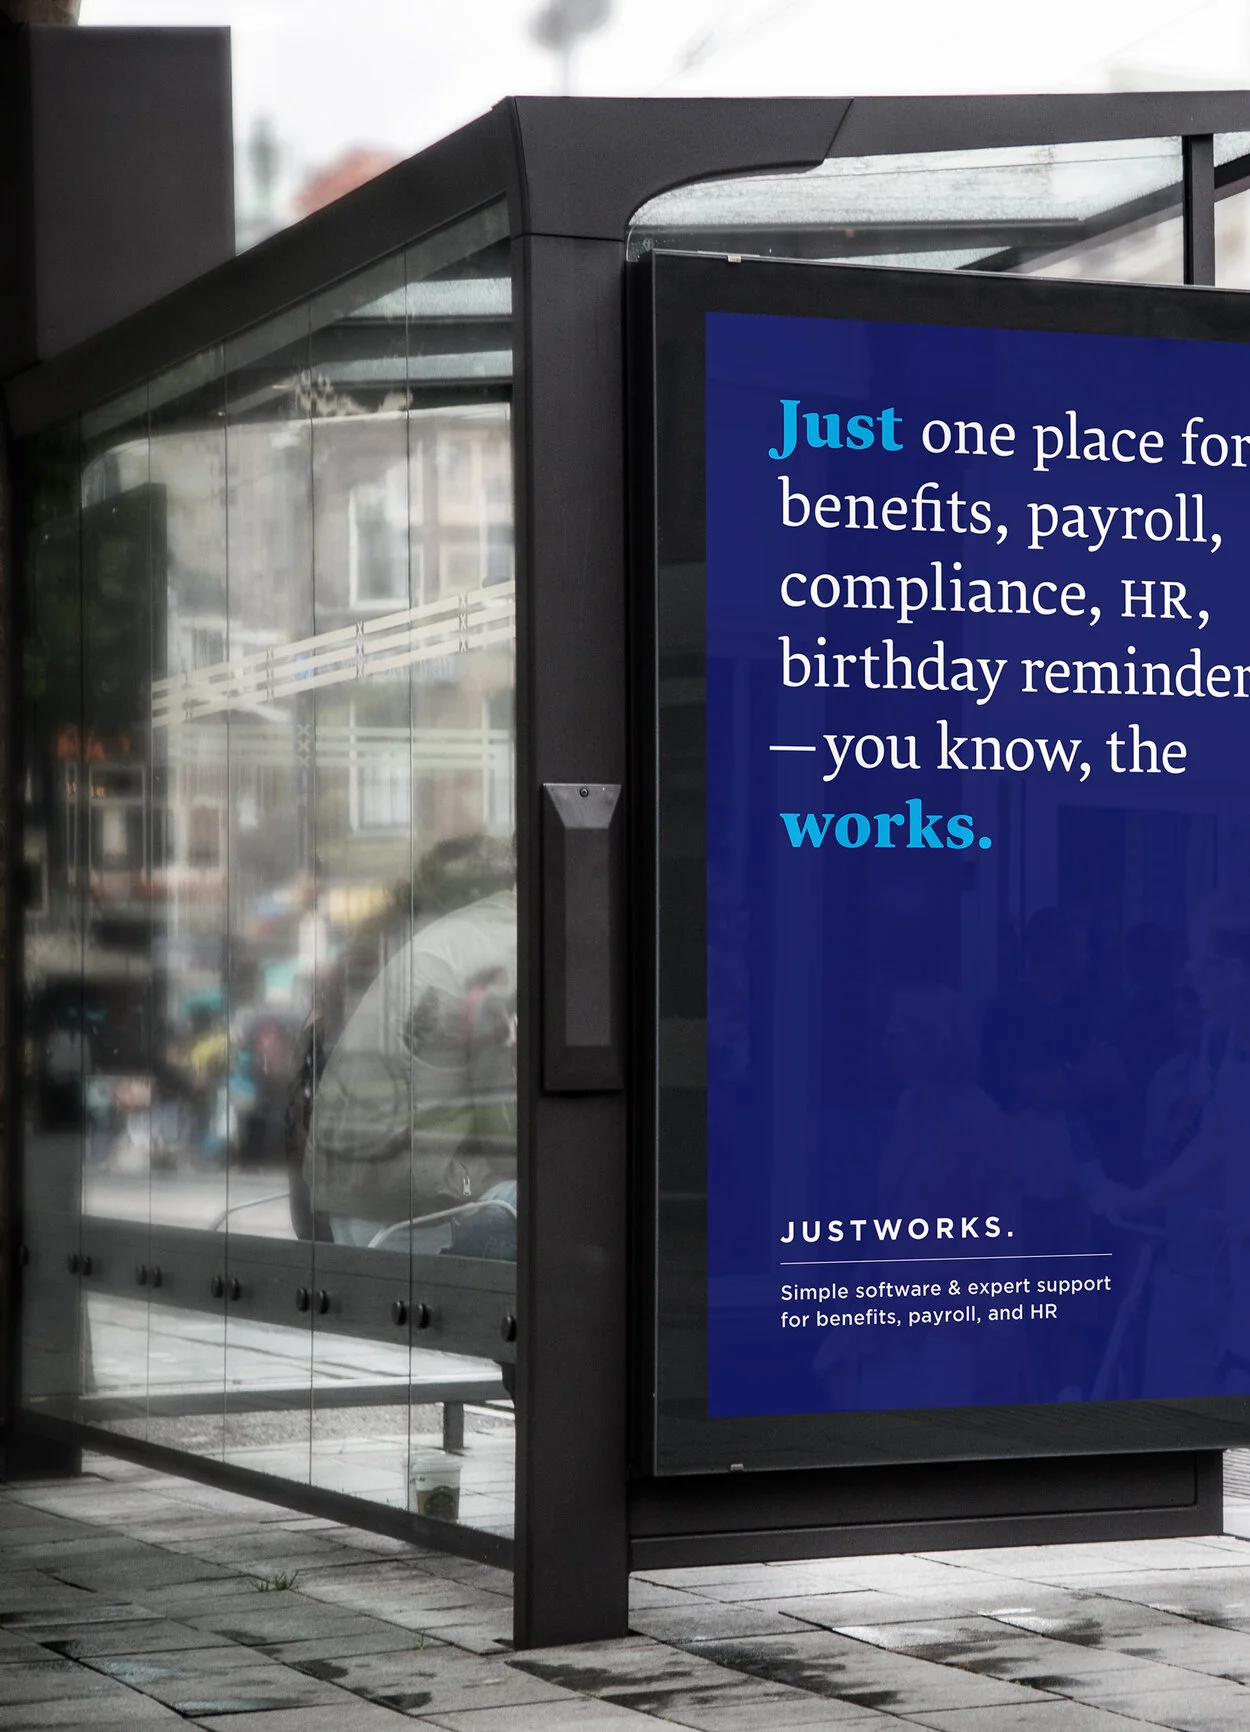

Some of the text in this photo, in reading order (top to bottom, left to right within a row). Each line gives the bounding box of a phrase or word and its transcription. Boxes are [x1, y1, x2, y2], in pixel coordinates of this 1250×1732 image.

[769, 399, 904, 460] Just
[922, 419, 1016, 457] one
[1032, 409, 1164, 472] place
[777, 475, 1222, 554] benefits, payroll,
[780, 560, 1210, 630] compliance, HR,
[777, 635, 1008, 706] birthday
[936, 719, 1091, 784] know,
[1105, 723, 1187, 775] the
[779, 798, 993, 850] works.
[780, 1216, 1015, 1244] JUSTWORKS.
[780, 1303, 1058, 1329] for benefits, payroll, and HR
[781, 1275, 1112, 1302] Simple software & expert support
